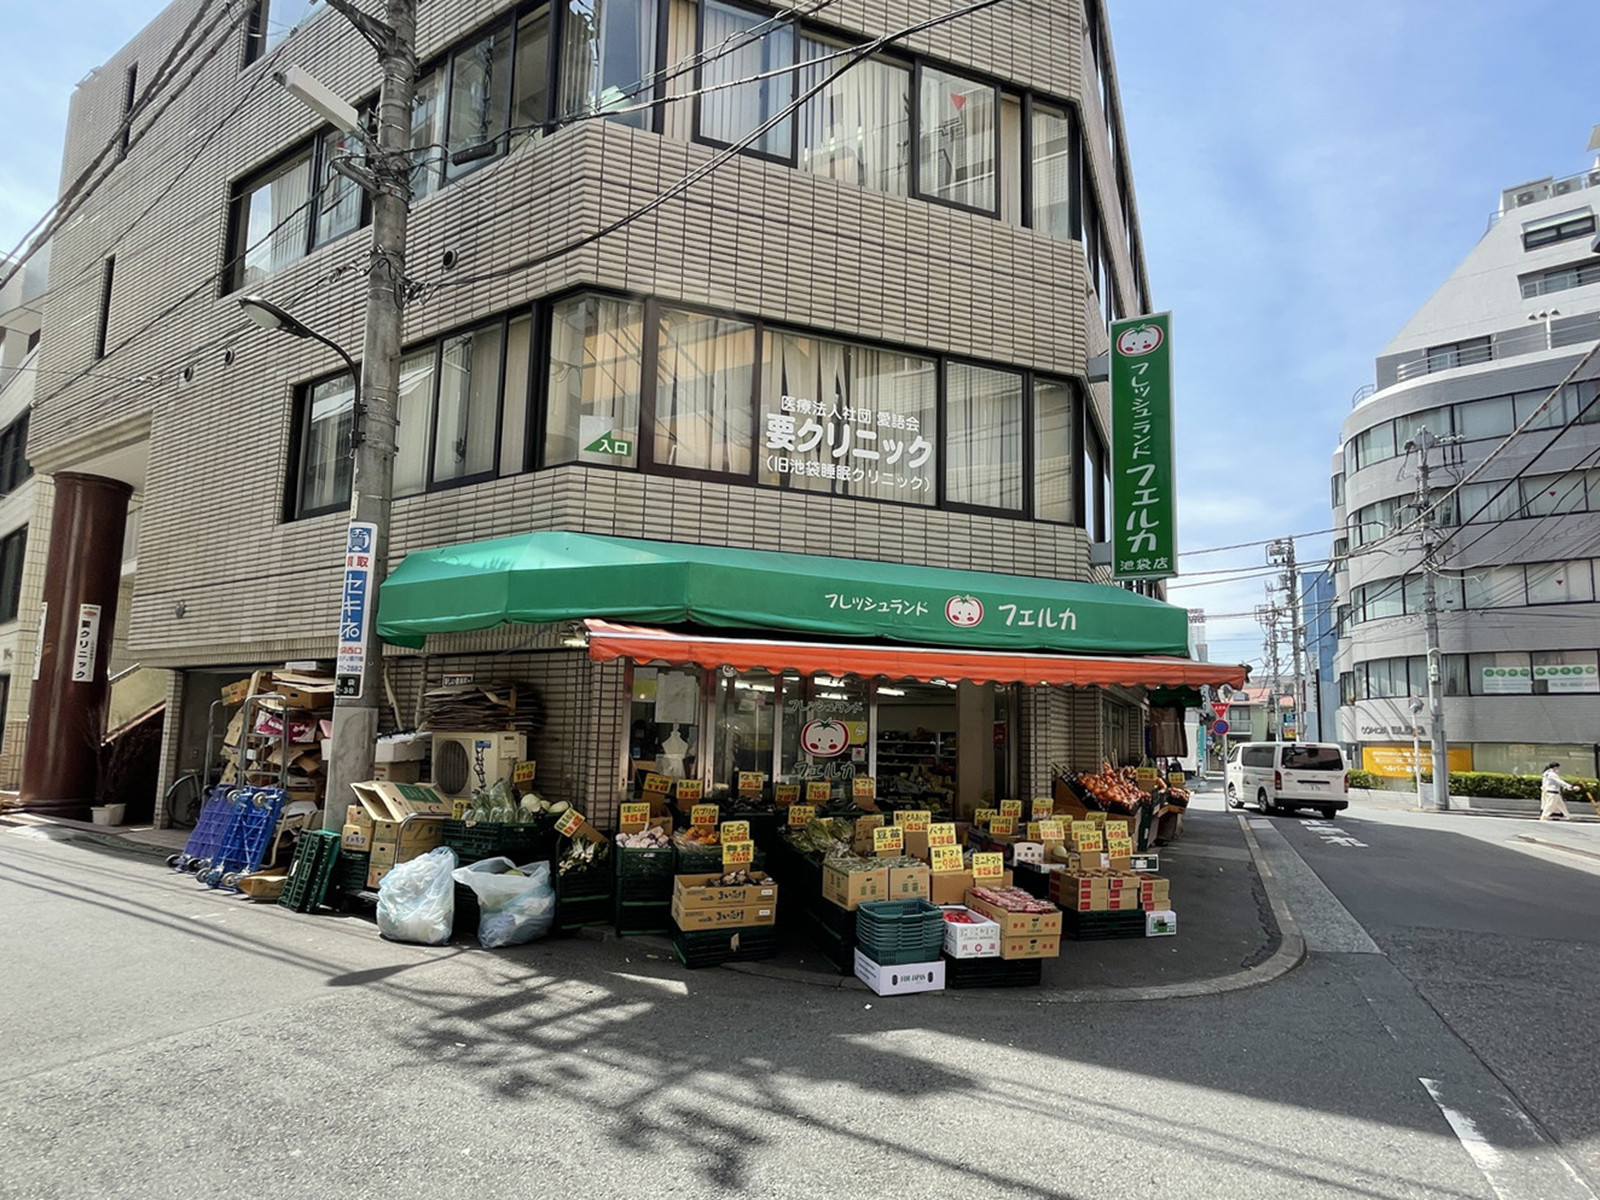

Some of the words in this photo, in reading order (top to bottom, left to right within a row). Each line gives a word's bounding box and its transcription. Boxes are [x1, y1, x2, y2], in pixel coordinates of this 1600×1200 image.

[781, 395, 872, 424] 医療法人社団
[599, 438, 629, 457] 入口
[766, 413, 932, 469] 要クリニック
[1125, 464, 1161, 554] フェルカ
[1119, 558, 1169, 571] 池袋店
[825, 593, 929, 617] フレッシュランド
[998, 603, 1077, 631] フェルカ
[795, 760, 857, 780] フェルカ
[929, 826, 954, 836] バナナ
[974, 857, 1002, 867] ミニトマト
